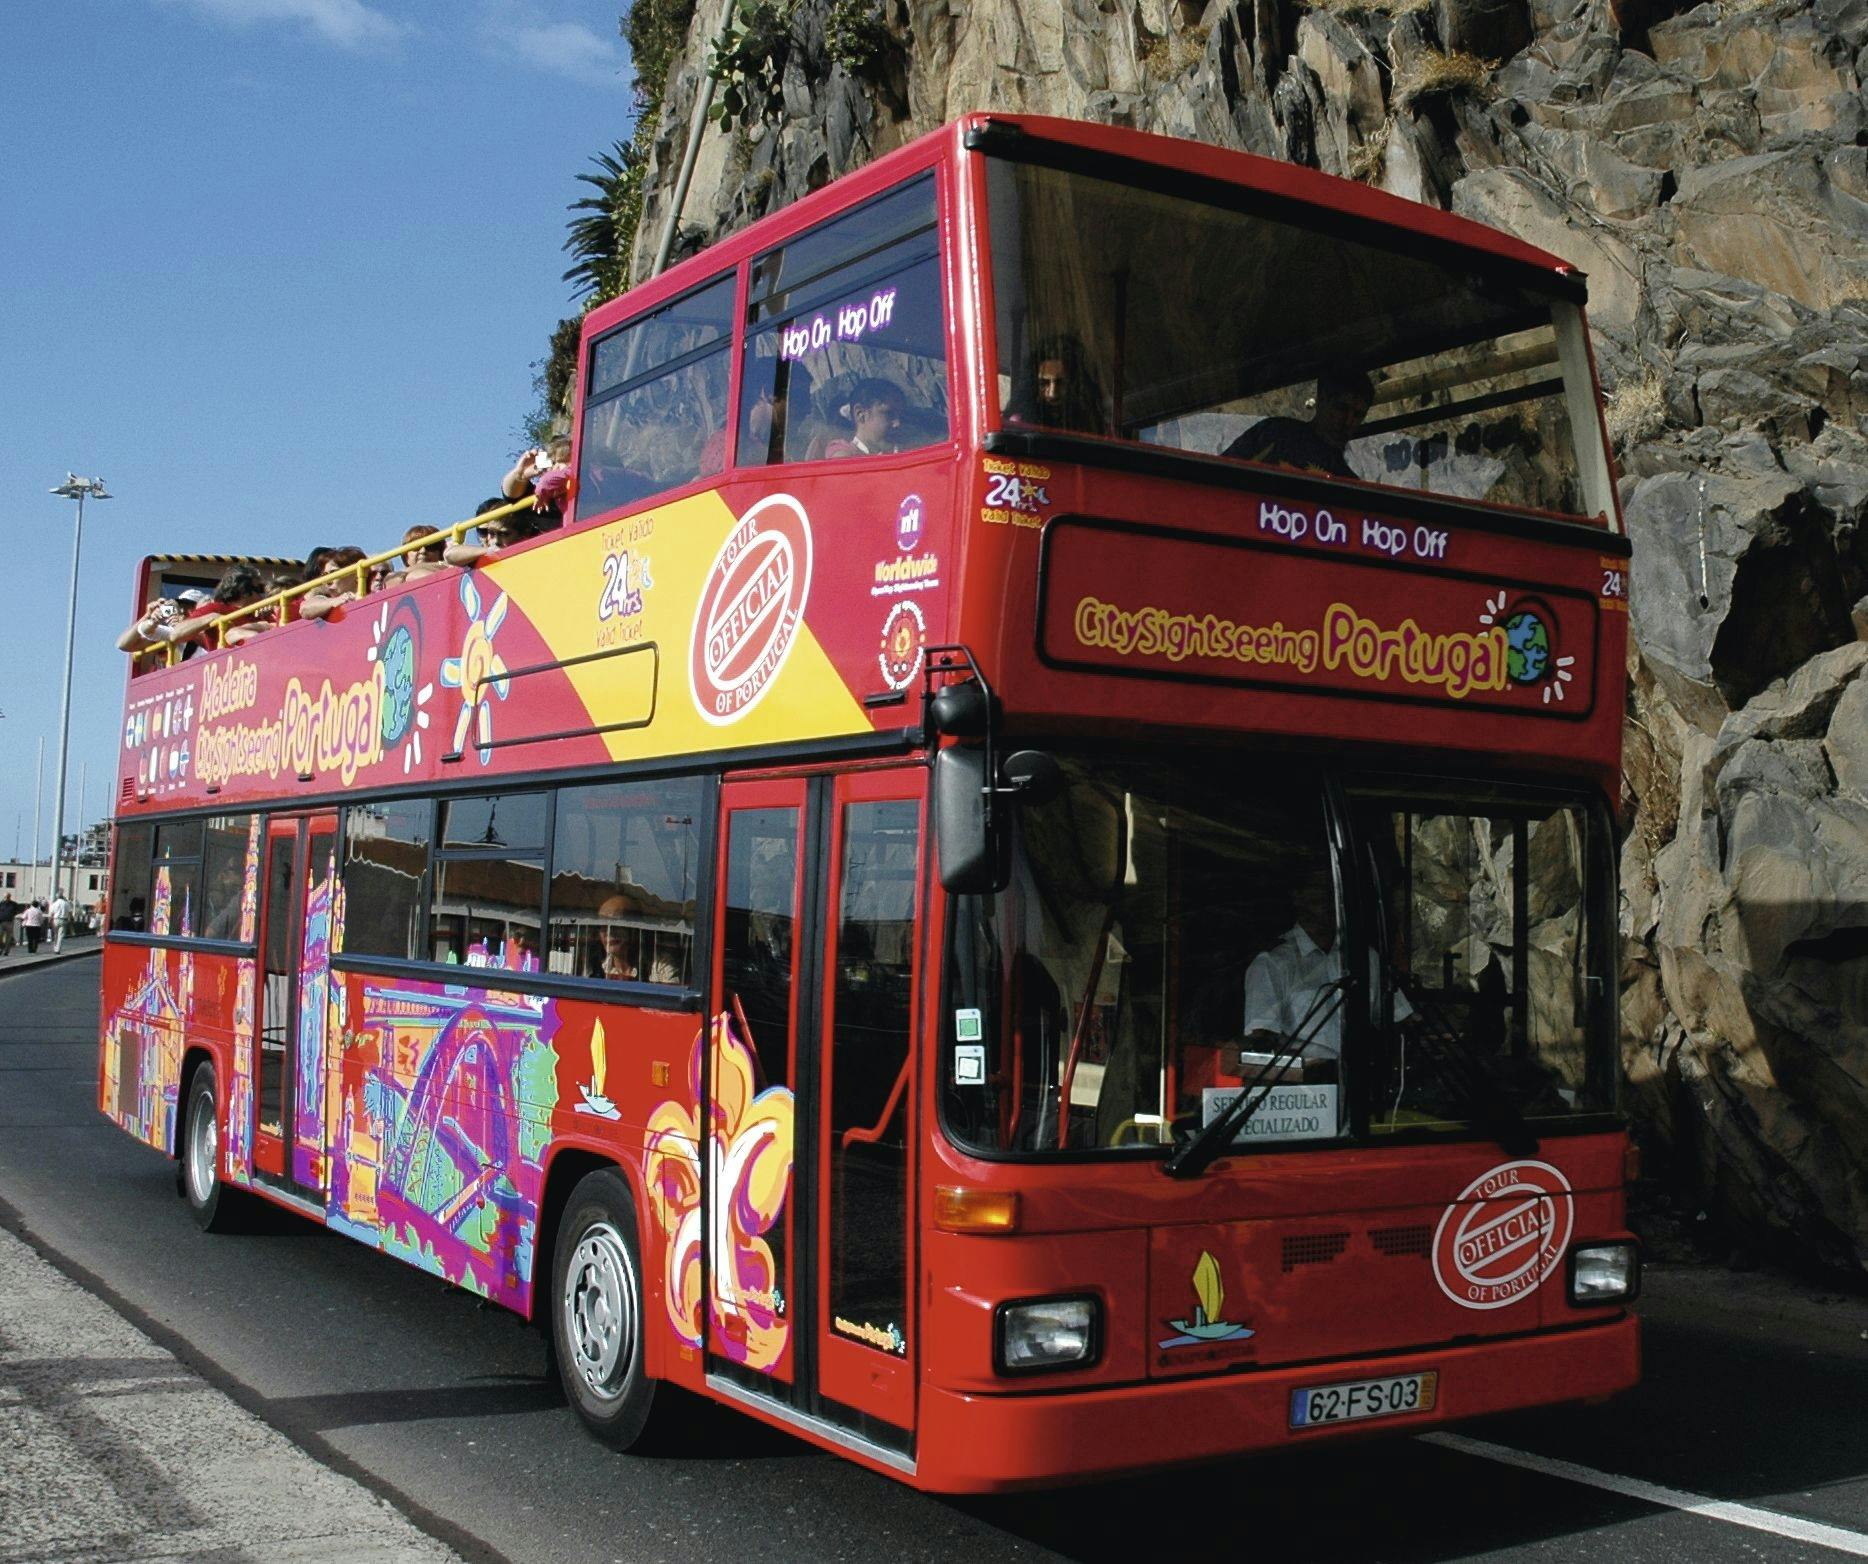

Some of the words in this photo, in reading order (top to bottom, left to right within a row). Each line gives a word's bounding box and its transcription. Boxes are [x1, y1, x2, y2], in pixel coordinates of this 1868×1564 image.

[782, 328, 810, 358] Hop
[811, 317, 831, 349] On
[837, 307, 867, 338] Hop
[869, 291, 896, 329] Off
[985, 475, 1020, 508] 24
[717, 518, 759, 578] TOUR
[1259, 501, 1308, 540] Hop
[1314, 509, 1347, 544] On
[1361, 518, 1407, 556] Hop
[1413, 526, 1449, 559] Off
[599, 549, 629, 622] 24
[708, 551, 789, 670] OFFICIAL
[1601, 569, 1622, 596] 24
[715, 690, 734, 714] OF
[734, 606, 799, 710] PORTUGAL
[1075, 596, 1320, 674] CitySightseeing
[1322, 602, 1508, 699] Portugal
[198, 656, 257, 723] Madeira
[280, 676, 386, 787] Portugal
[1270, 1093, 1328, 1111] REGULAR
[1474, 1169, 1520, 1199] TOUR
[1459, 1200, 1552, 1265] OFFICIAL
[1467, 1284, 1489, 1302] OF
[1491, 1244, 1558, 1300] PORTUGAL
